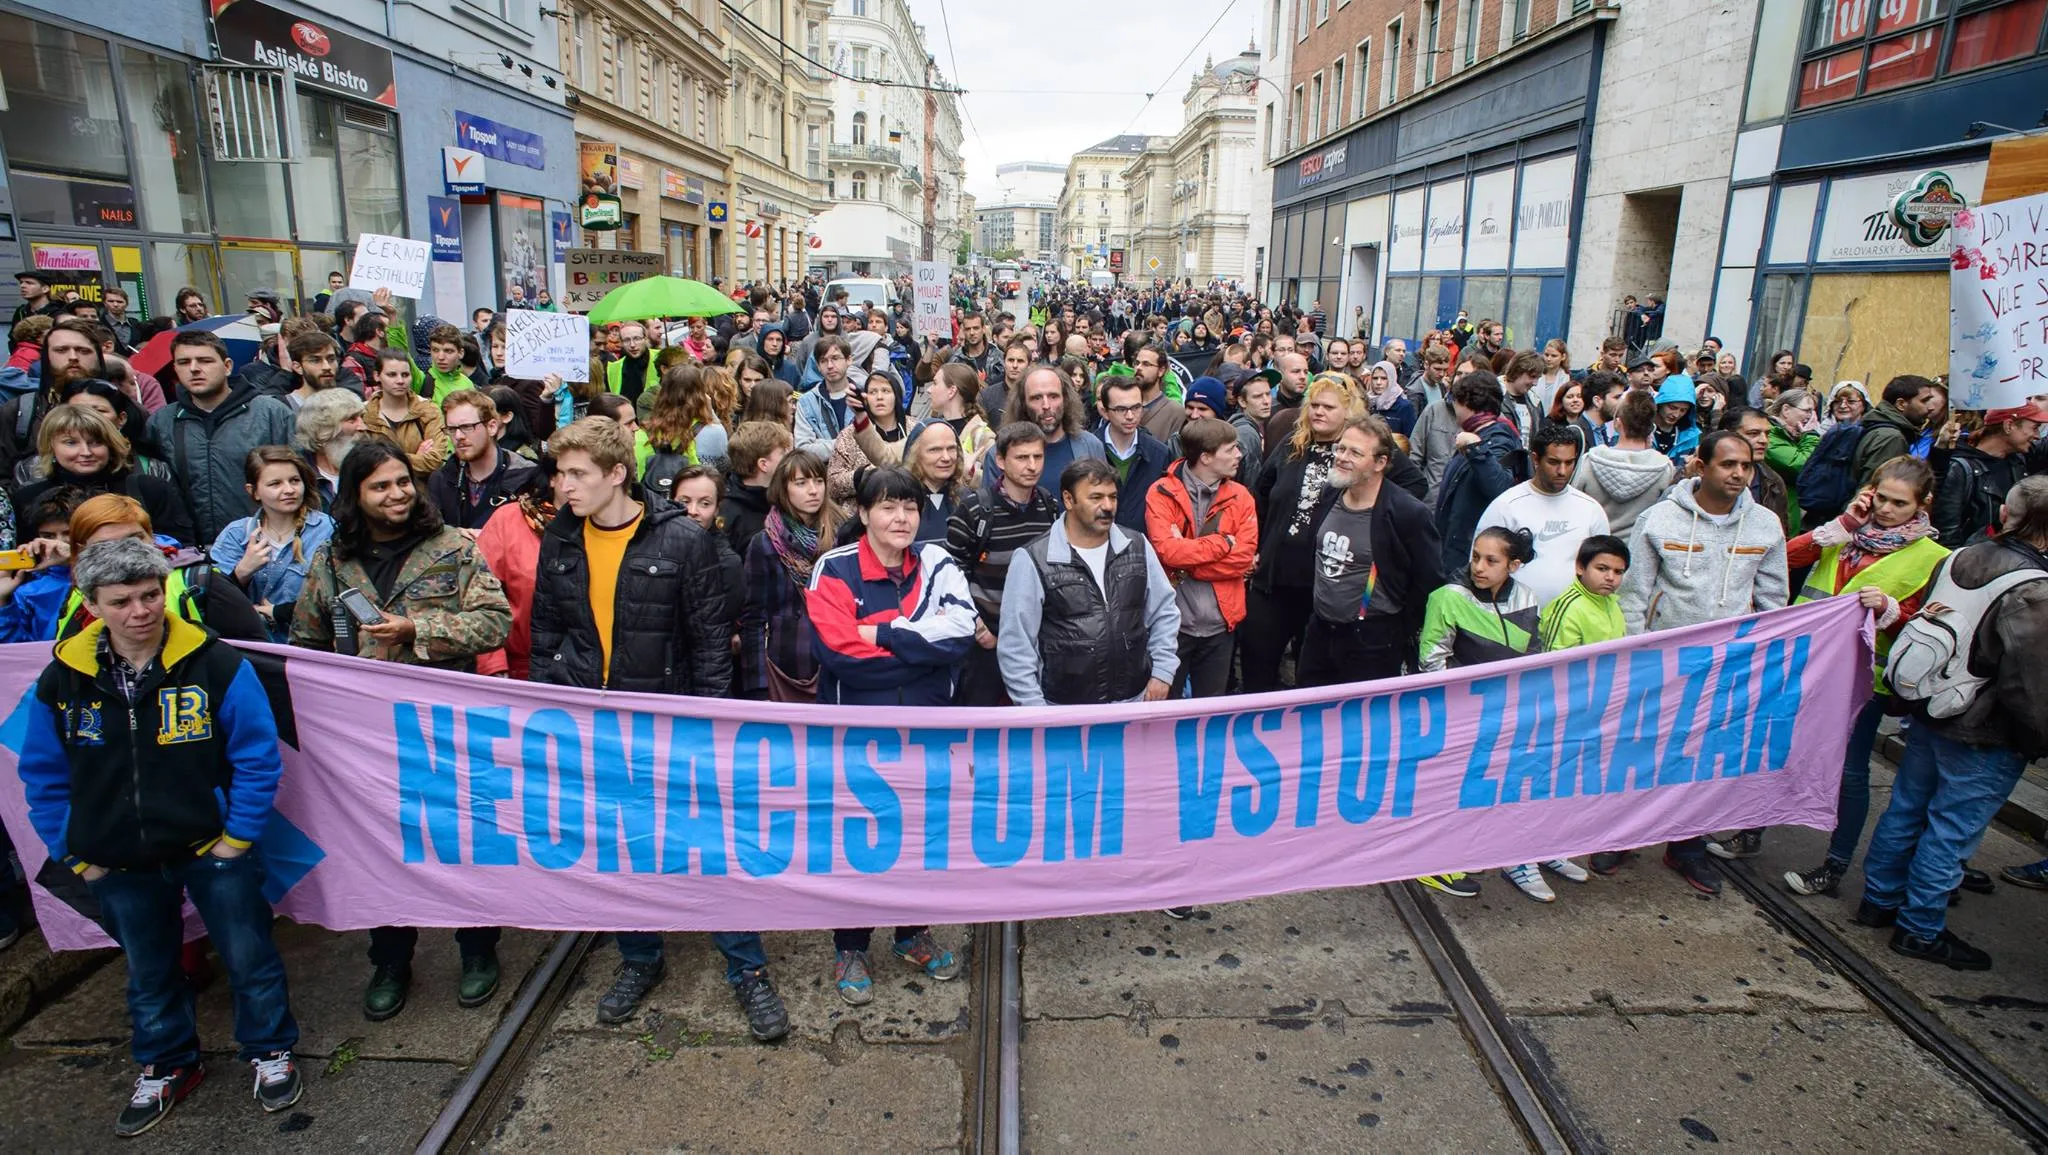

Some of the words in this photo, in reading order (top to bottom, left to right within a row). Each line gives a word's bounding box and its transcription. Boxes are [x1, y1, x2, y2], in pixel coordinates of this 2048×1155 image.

[254, 40, 319, 78] Asijské
[322, 61, 368, 92] Bistro
[469, 125, 497, 146] Tipsport
[1300, 152, 1324, 176] TESCO
[452, 184, 479, 193] Tipsport
[101, 208, 133, 222] NAILS
[1862, 210, 1904, 241] Thu
[435, 233, 460, 248] Tipsport
[35, 249, 90, 269] Manikúra
[608, 254, 620, 264] JE
[919, 268, 935, 281] KDO
[917, 285, 944, 299] MILUJE
[922, 302, 938, 314] TEN
[507, 310, 538, 337] NECH
[1543, 520, 1569, 532] NIKE
[394, 702, 1127, 878] NEONACISTUM
[1174, 686, 1447, 844] VSTUP
[1459, 618, 1811, 809] ZAKAZÁN
